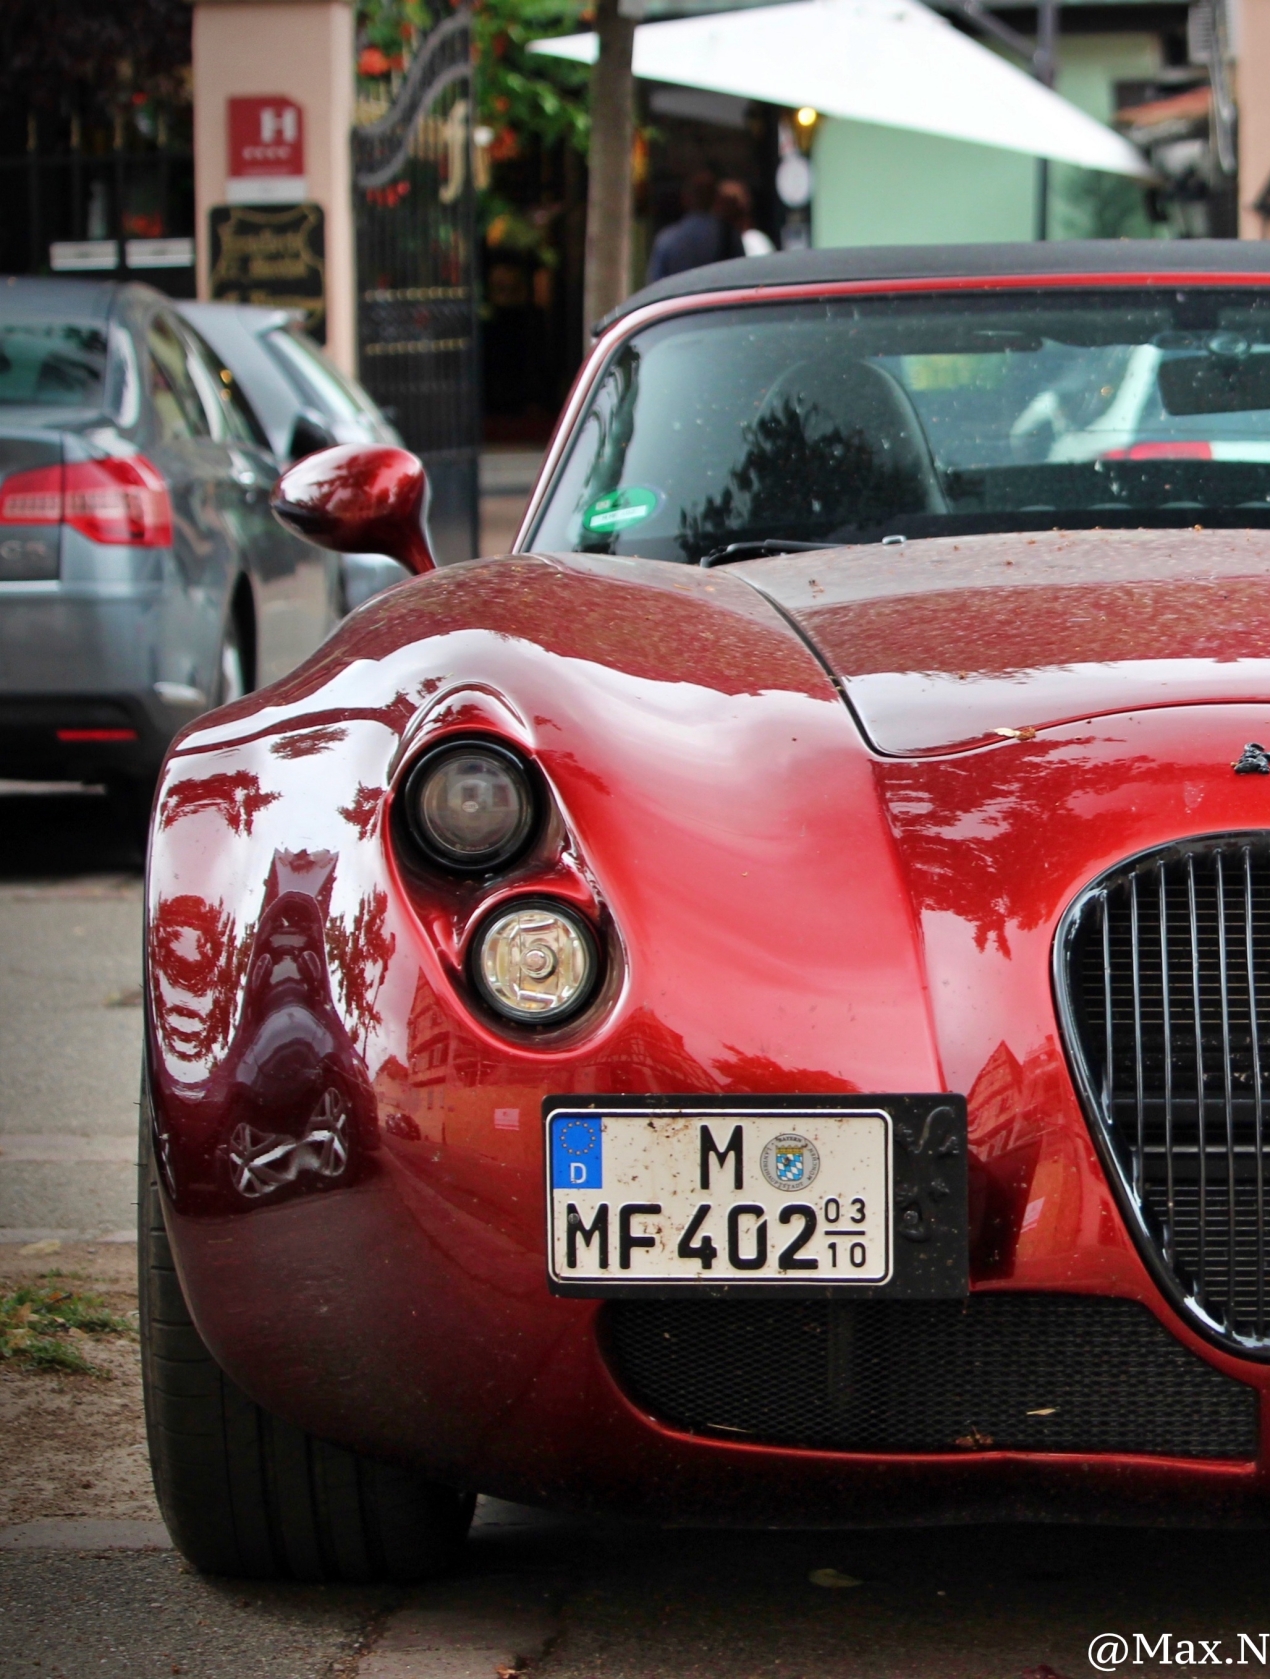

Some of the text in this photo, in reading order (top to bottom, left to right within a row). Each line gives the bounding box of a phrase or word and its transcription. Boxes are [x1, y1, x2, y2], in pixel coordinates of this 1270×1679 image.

[259, 106, 298, 144] H
[570, 1162, 587, 1184] D
[700, 1124, 744, 1190] M
[566, 1203, 819, 1271] MF 402
[828, 1242, 867, 1268] 10
